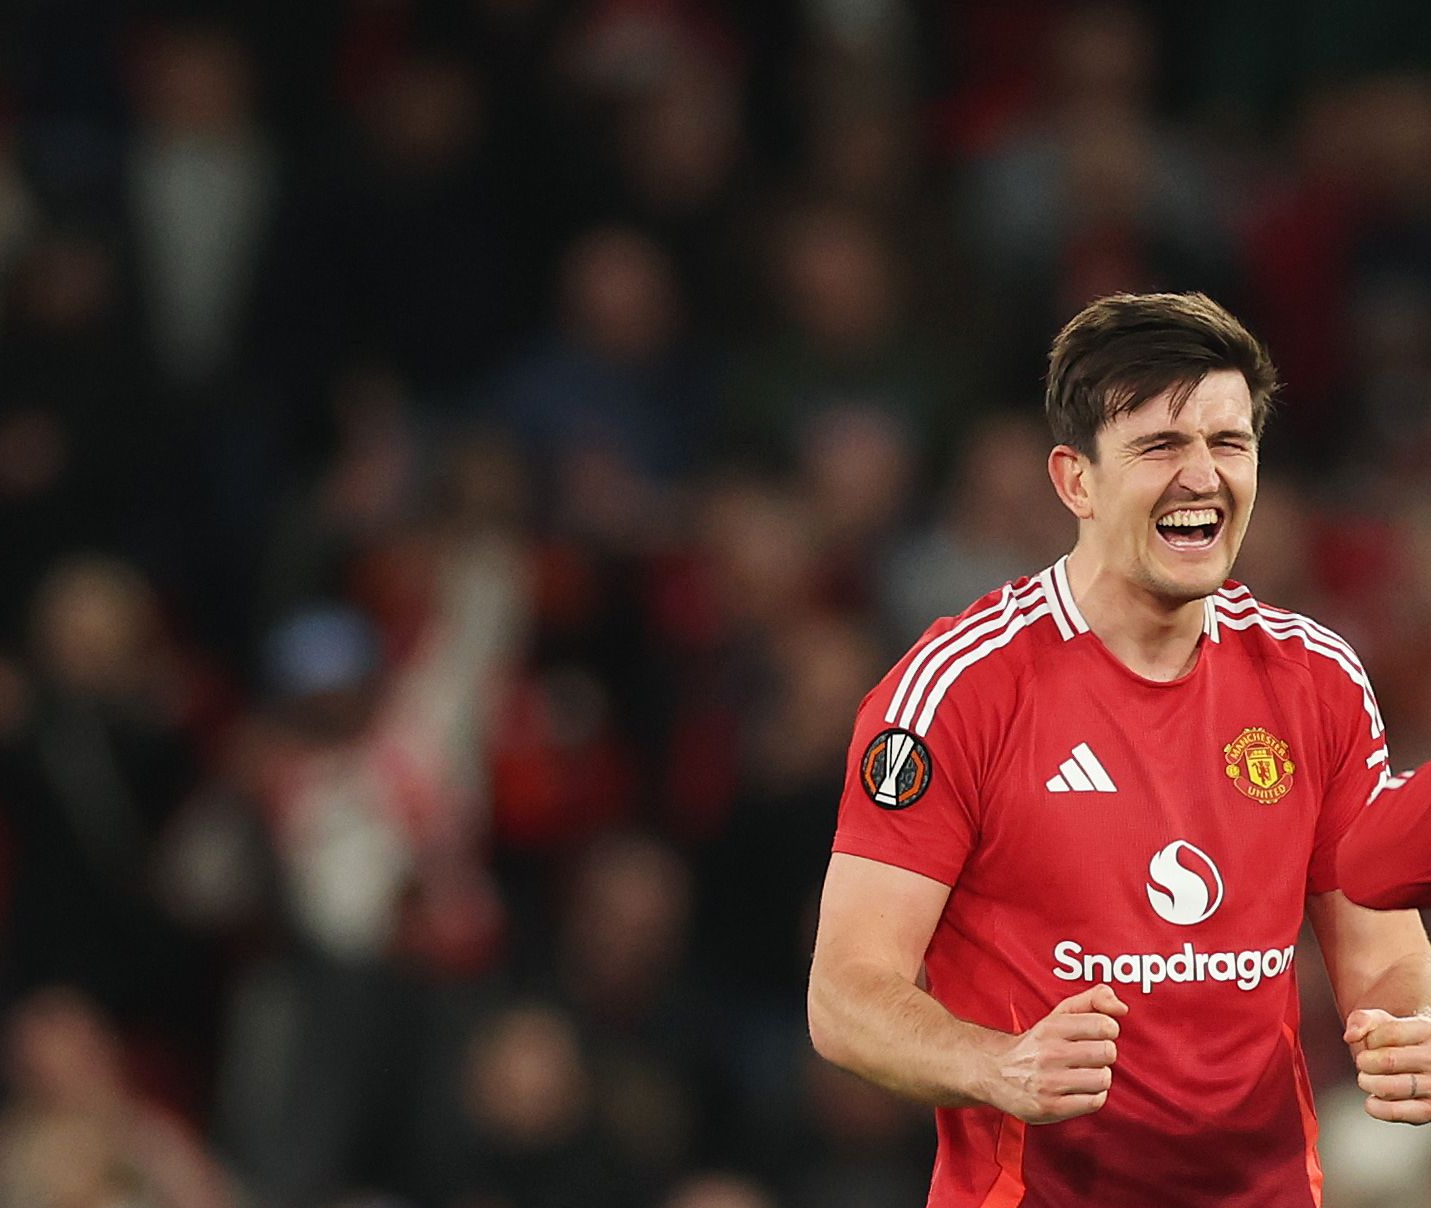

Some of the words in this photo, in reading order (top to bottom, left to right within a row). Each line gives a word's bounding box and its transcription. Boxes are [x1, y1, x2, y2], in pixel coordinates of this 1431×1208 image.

[1230, 732, 1286, 760] MANCHESTER
[1248, 784, 1286, 799] UNITED
[1053, 940, 1295, 994] Snapdragon
